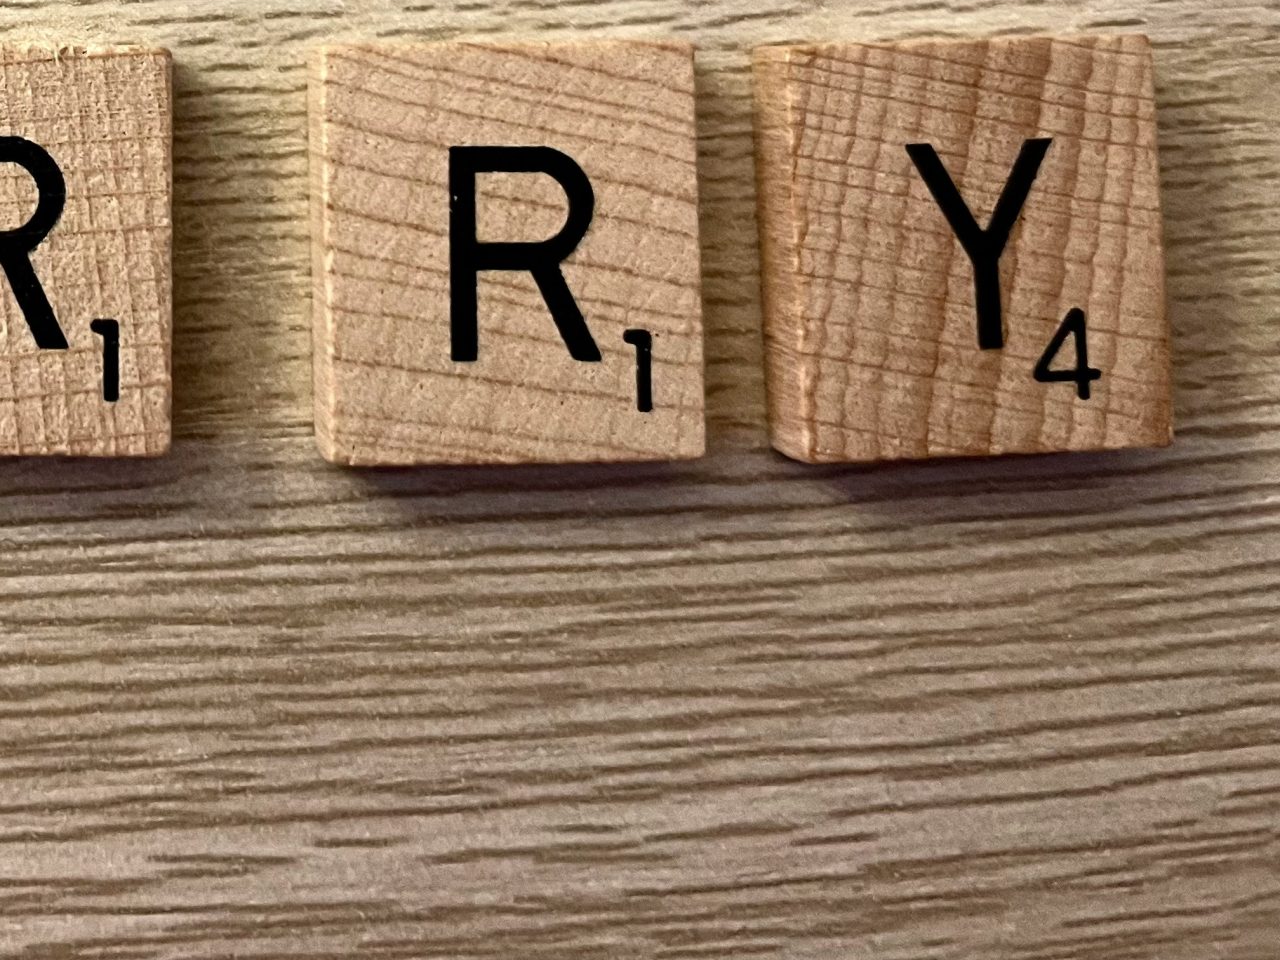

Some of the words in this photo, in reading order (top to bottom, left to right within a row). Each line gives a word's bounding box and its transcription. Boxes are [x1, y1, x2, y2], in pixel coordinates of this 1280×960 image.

[90, 319, 119, 402] 1
[623, 329, 653, 412] 1
[1032, 308, 1102, 400] 4
